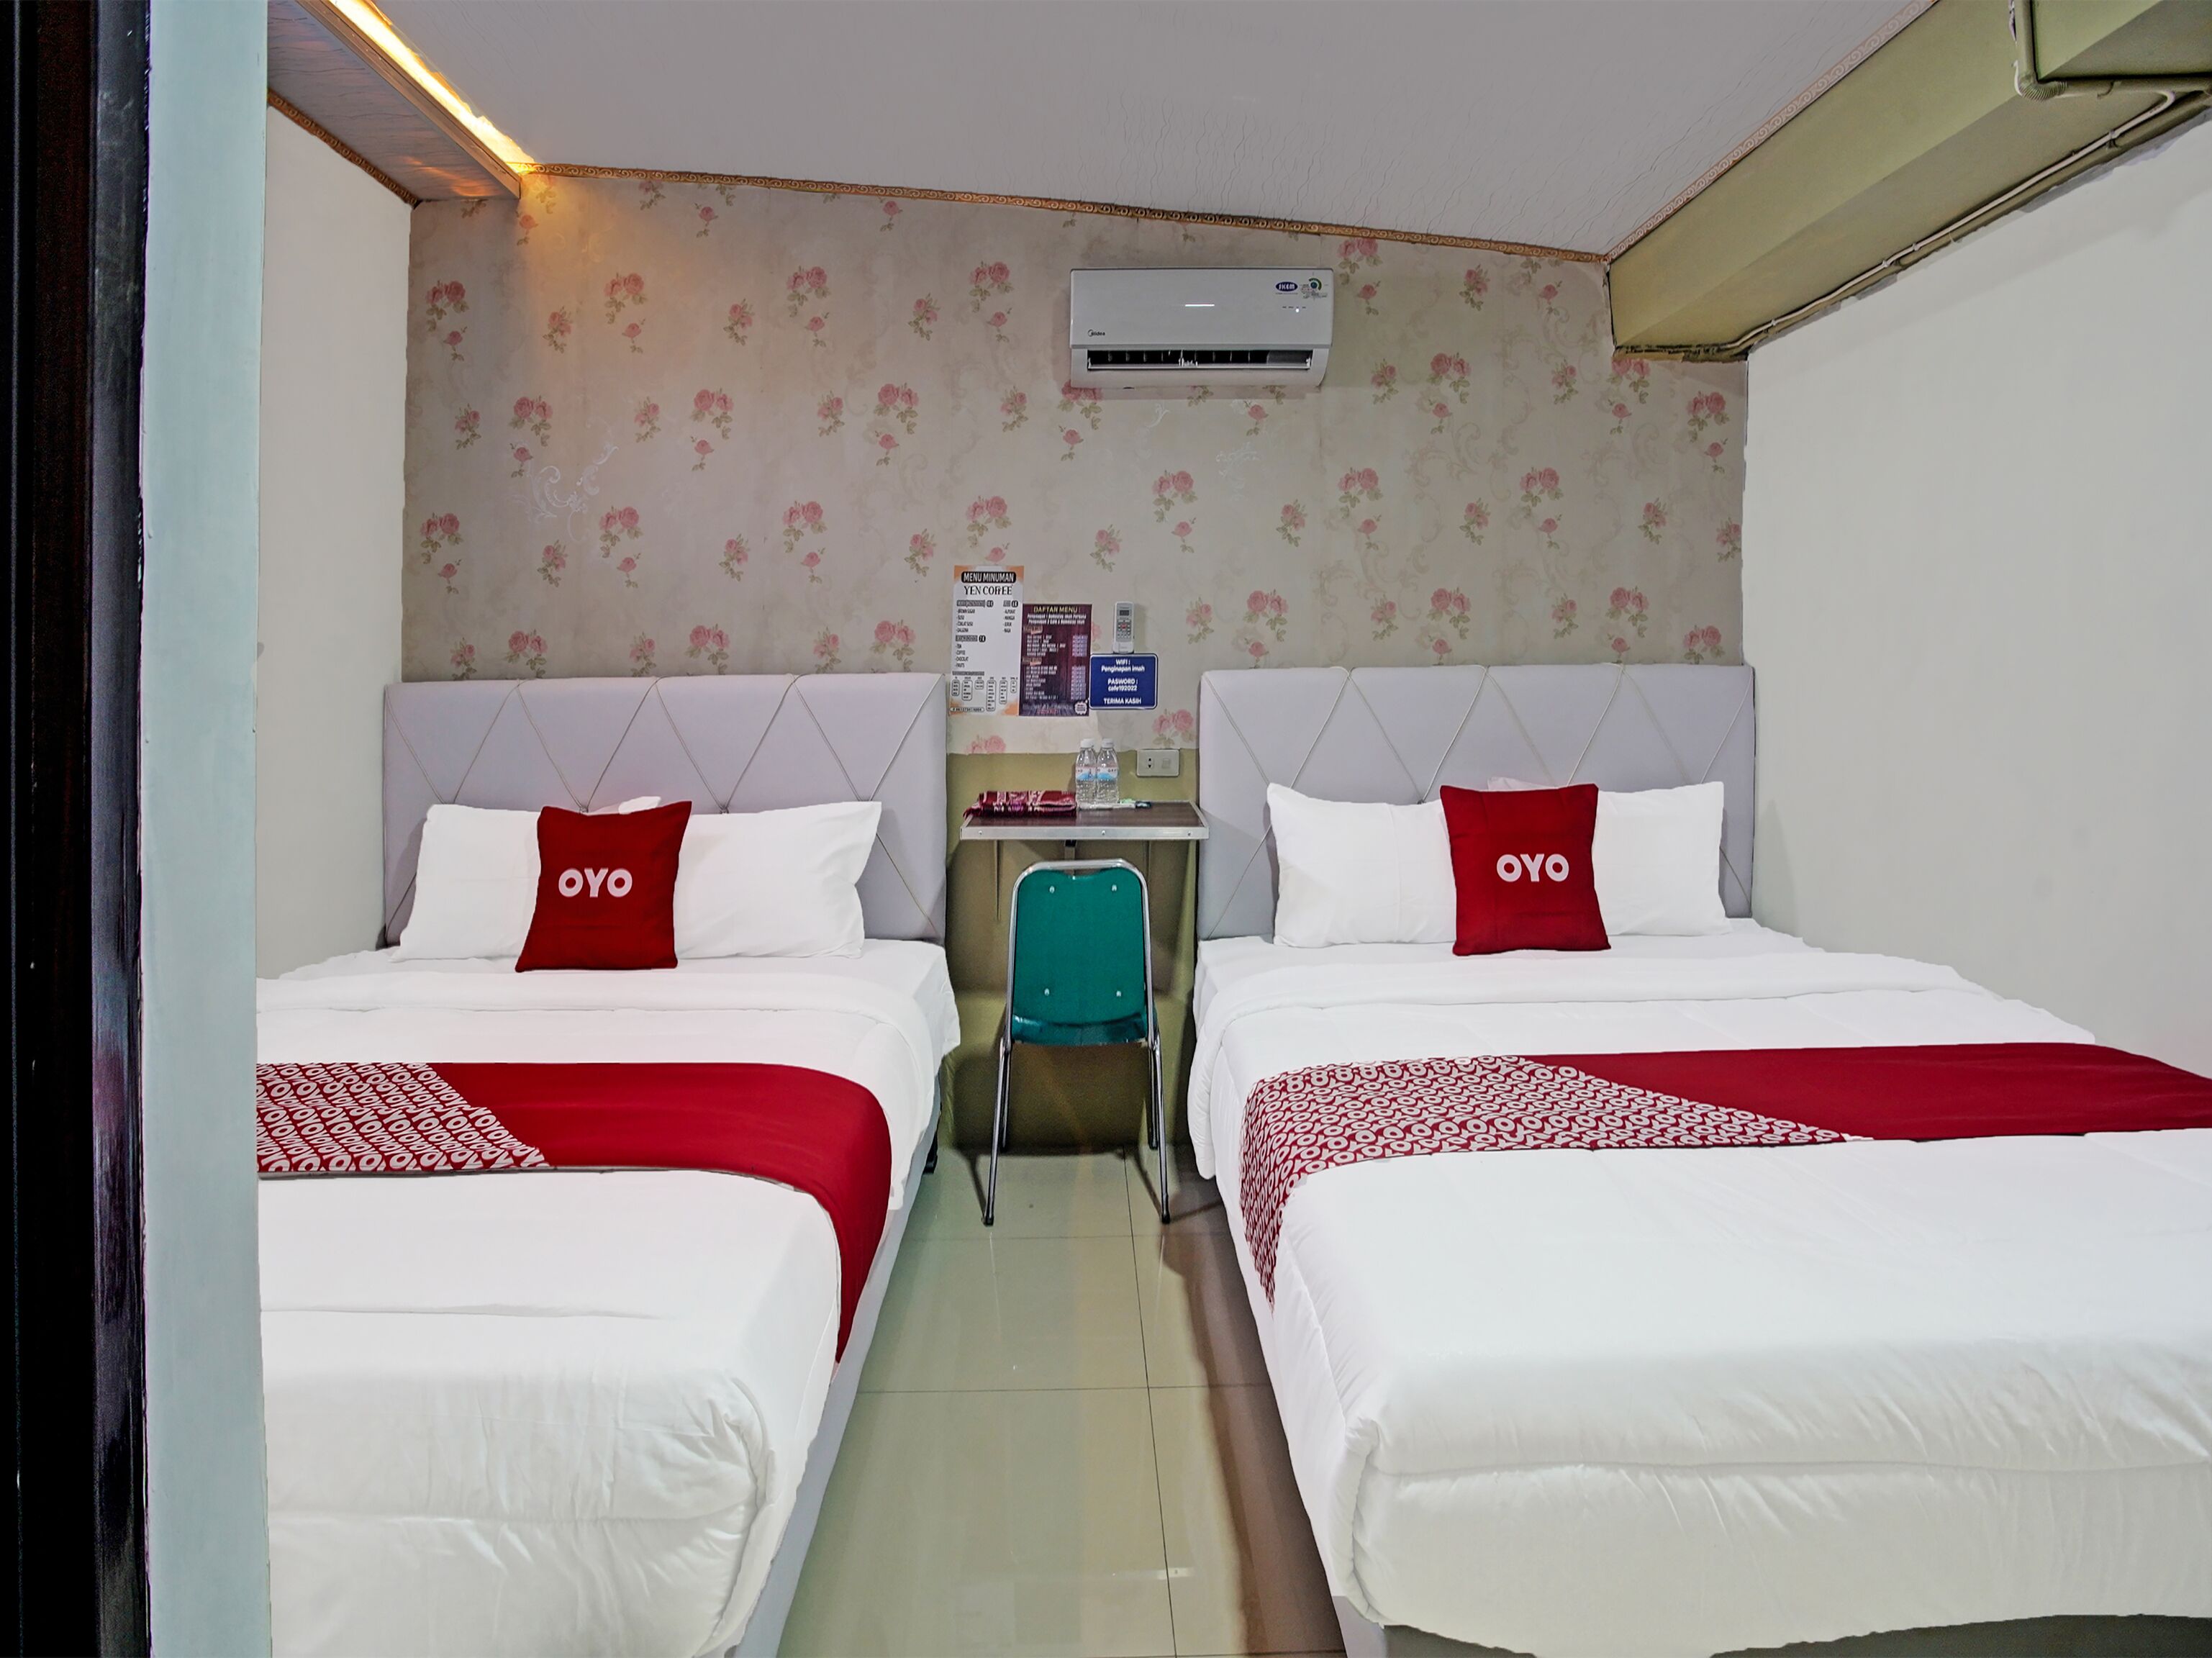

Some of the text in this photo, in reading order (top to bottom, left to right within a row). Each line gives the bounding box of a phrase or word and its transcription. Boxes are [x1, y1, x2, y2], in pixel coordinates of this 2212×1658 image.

[964, 573, 1014, 581] MENU MINUMAN
[964, 585, 1012, 595] YEN COFFEE
[1496, 853, 1569, 882] OYO
[558, 868, 633, 897] OYO
